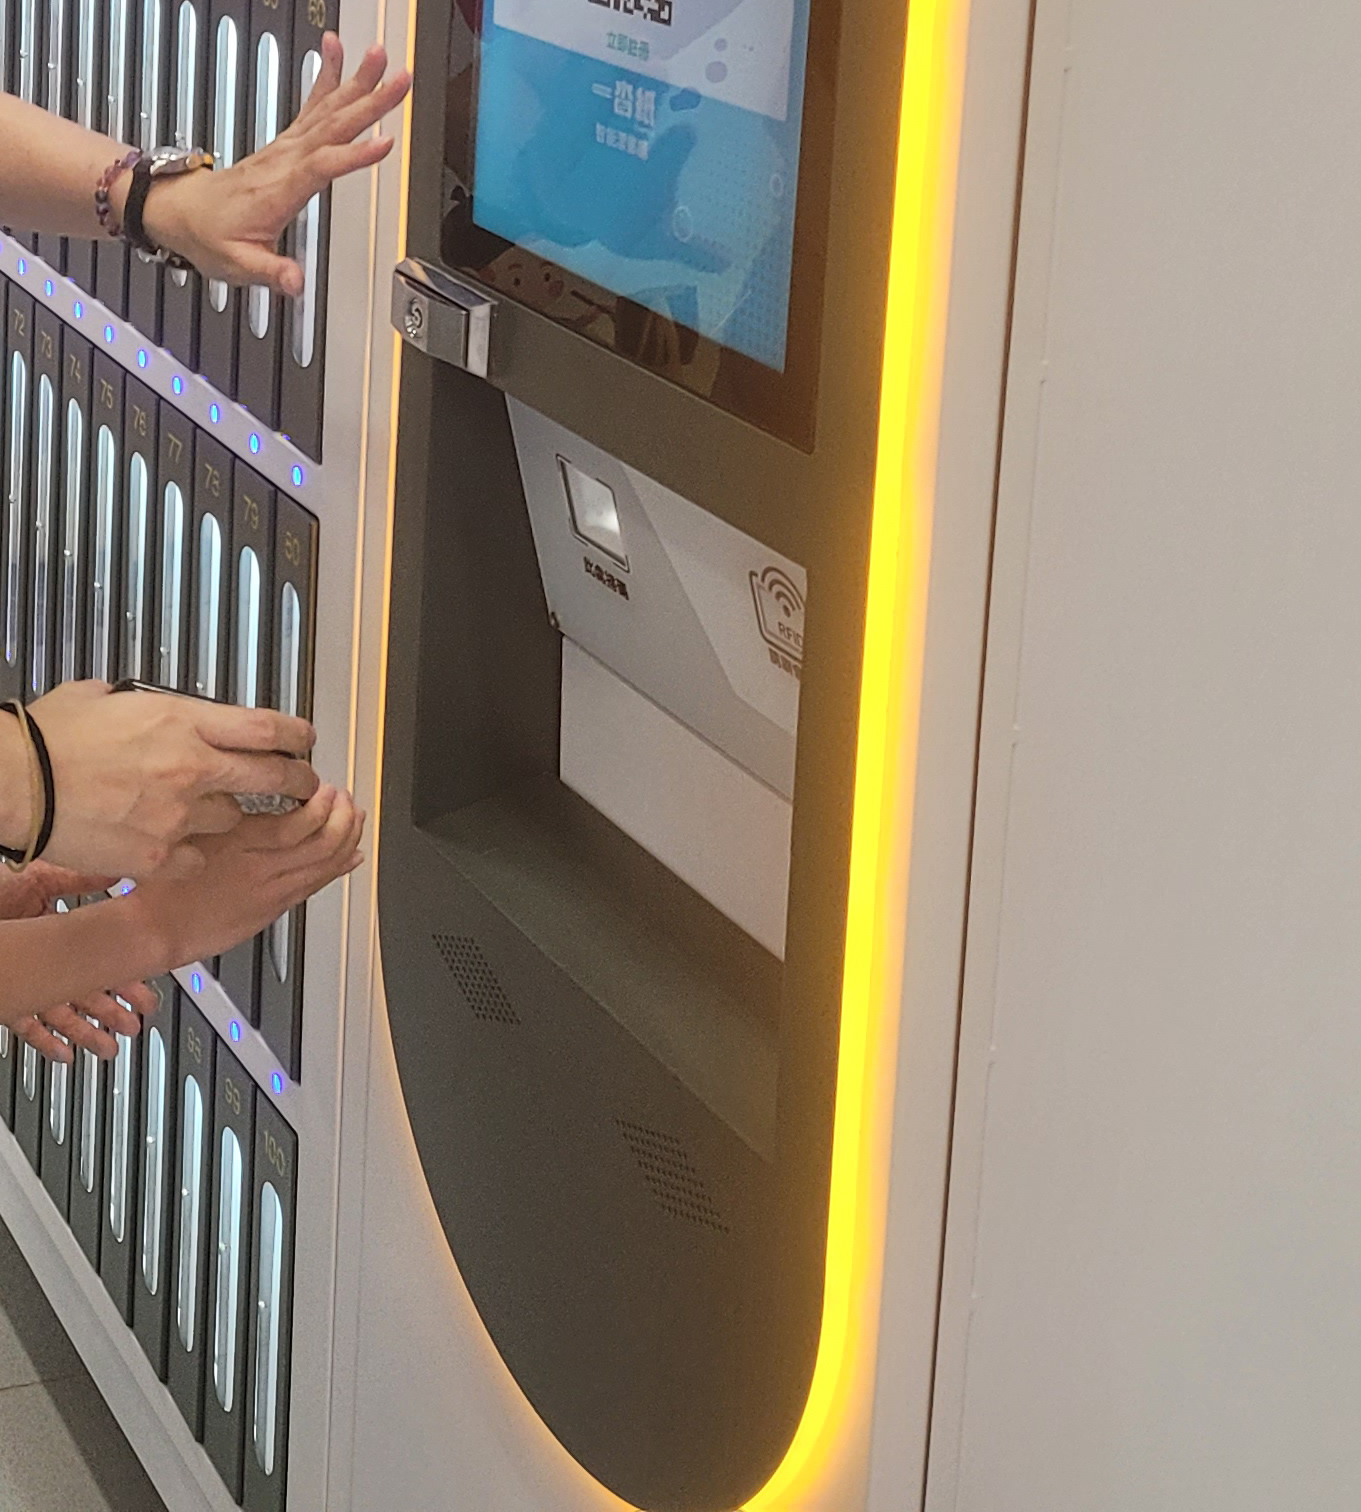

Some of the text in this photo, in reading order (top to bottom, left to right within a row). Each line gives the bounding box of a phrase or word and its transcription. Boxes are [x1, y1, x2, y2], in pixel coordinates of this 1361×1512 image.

[14, 308, 25, 336] 72
[40, 330, 52, 358] 73
[68, 354, 81, 381] 74
[100, 378, 114, 410] 75
[132, 404, 147, 437] 76
[168, 433, 182, 464] 77
[204, 462, 220, 498] 78
[242, 494, 260, 530] 79
[264, 1130, 286, 1178] 100
